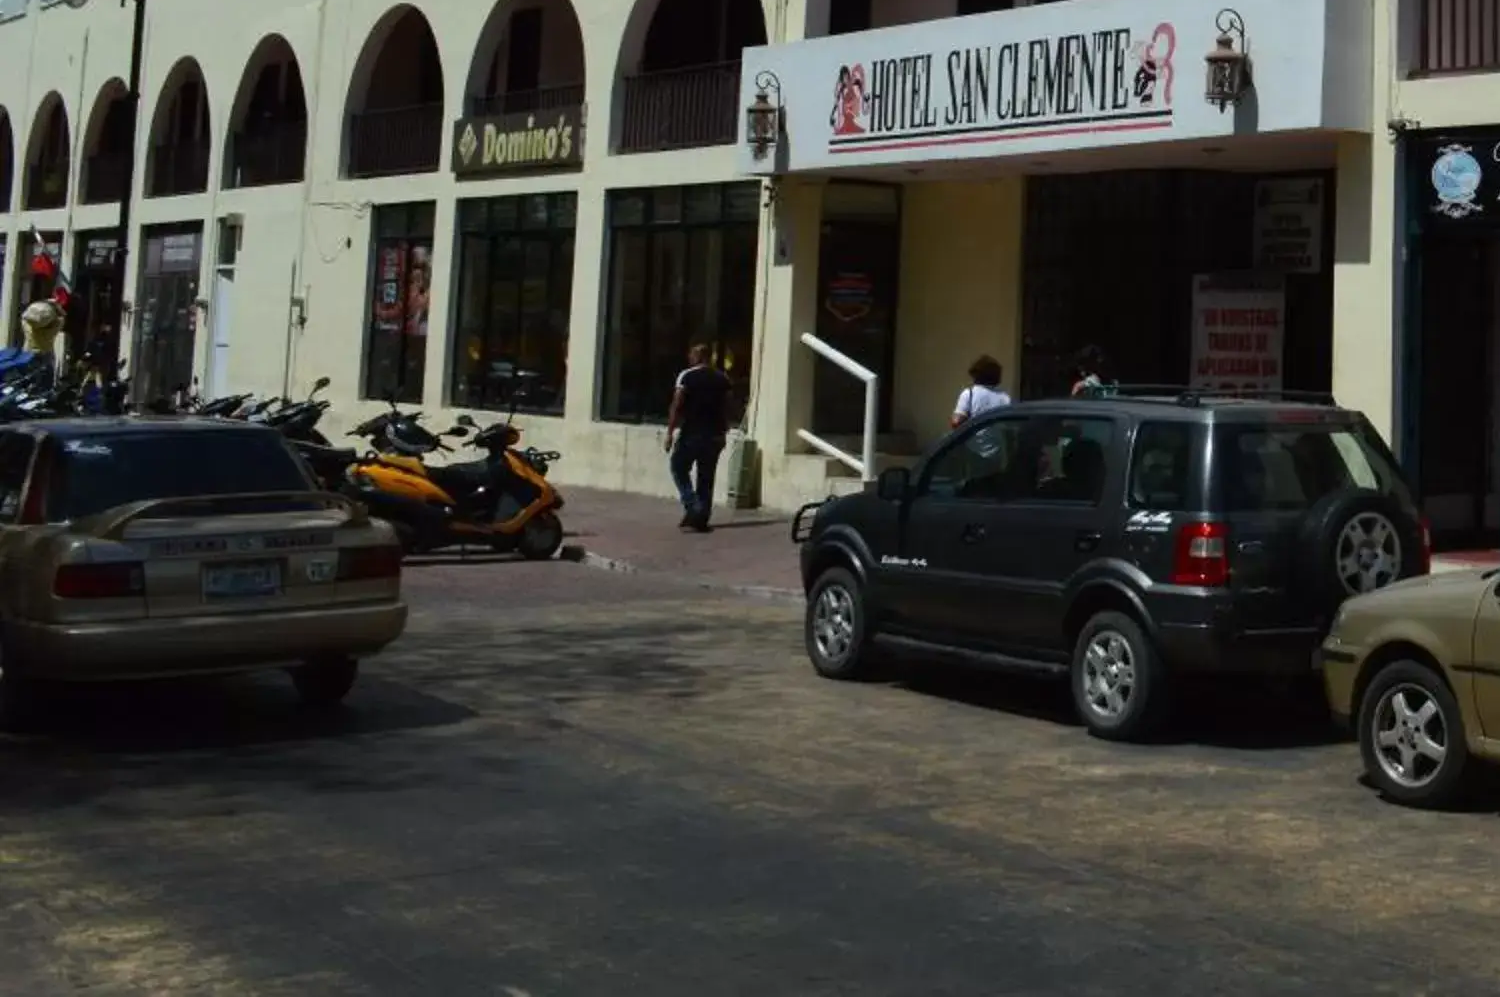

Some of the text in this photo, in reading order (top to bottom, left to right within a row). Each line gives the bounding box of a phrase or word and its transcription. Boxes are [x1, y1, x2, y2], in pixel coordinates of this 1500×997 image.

[869, 27, 1131, 133] HOTEL SAN CLEMENTE
[482, 113, 573, 164] Domino's
